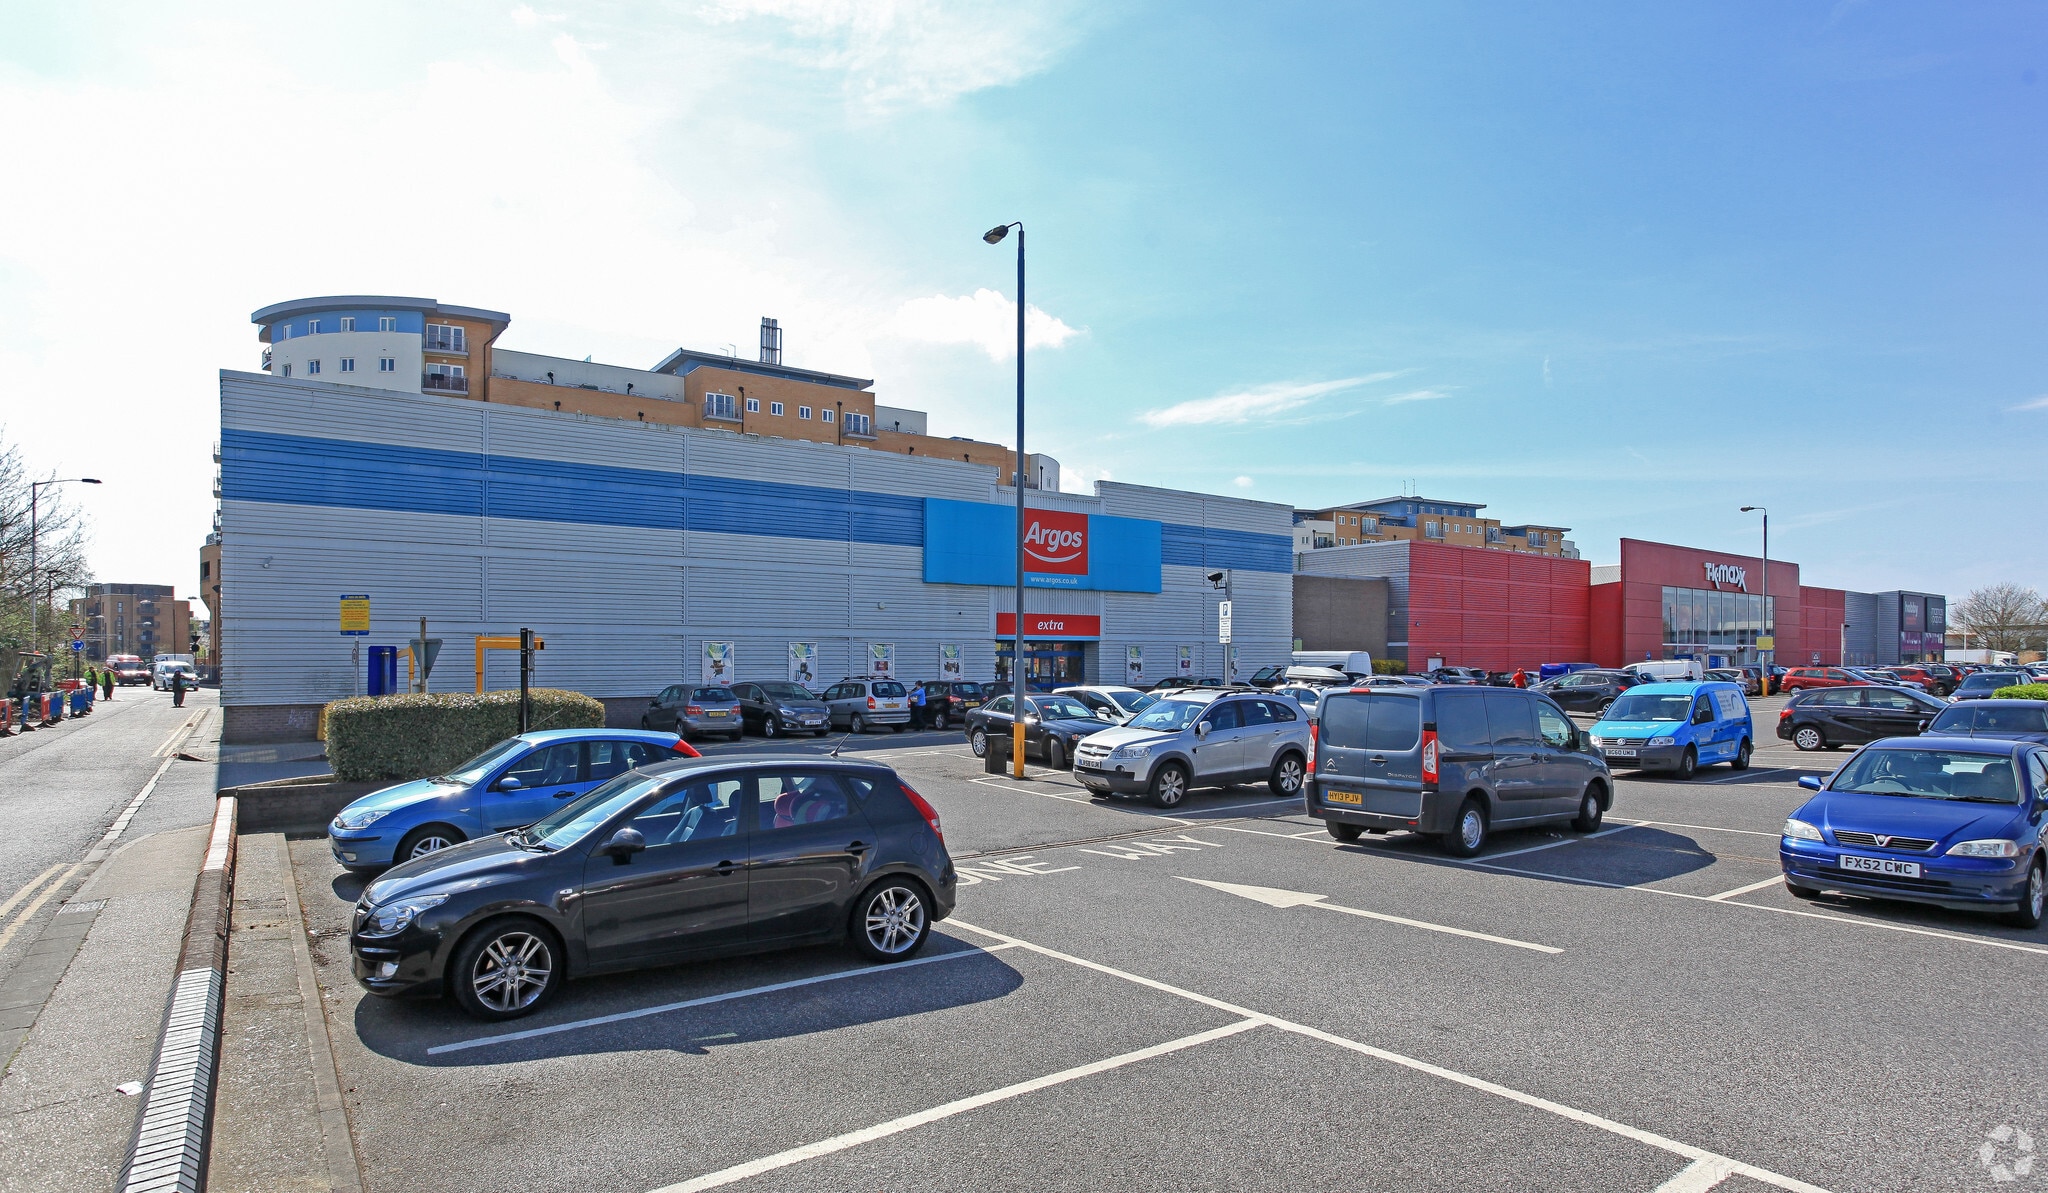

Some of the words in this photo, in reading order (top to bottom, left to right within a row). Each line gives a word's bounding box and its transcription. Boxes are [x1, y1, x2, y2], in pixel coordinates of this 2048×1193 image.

[1024, 521, 1083, 553] Argos
[1030, 576, 1078, 585] www.argos.co.uk
[1037, 620, 1064, 631] extra
[1078, 835, 1224, 860] WAY
[1845, 856, 1881, 871] FX52
[1884, 861, 1913, 875] CWC
